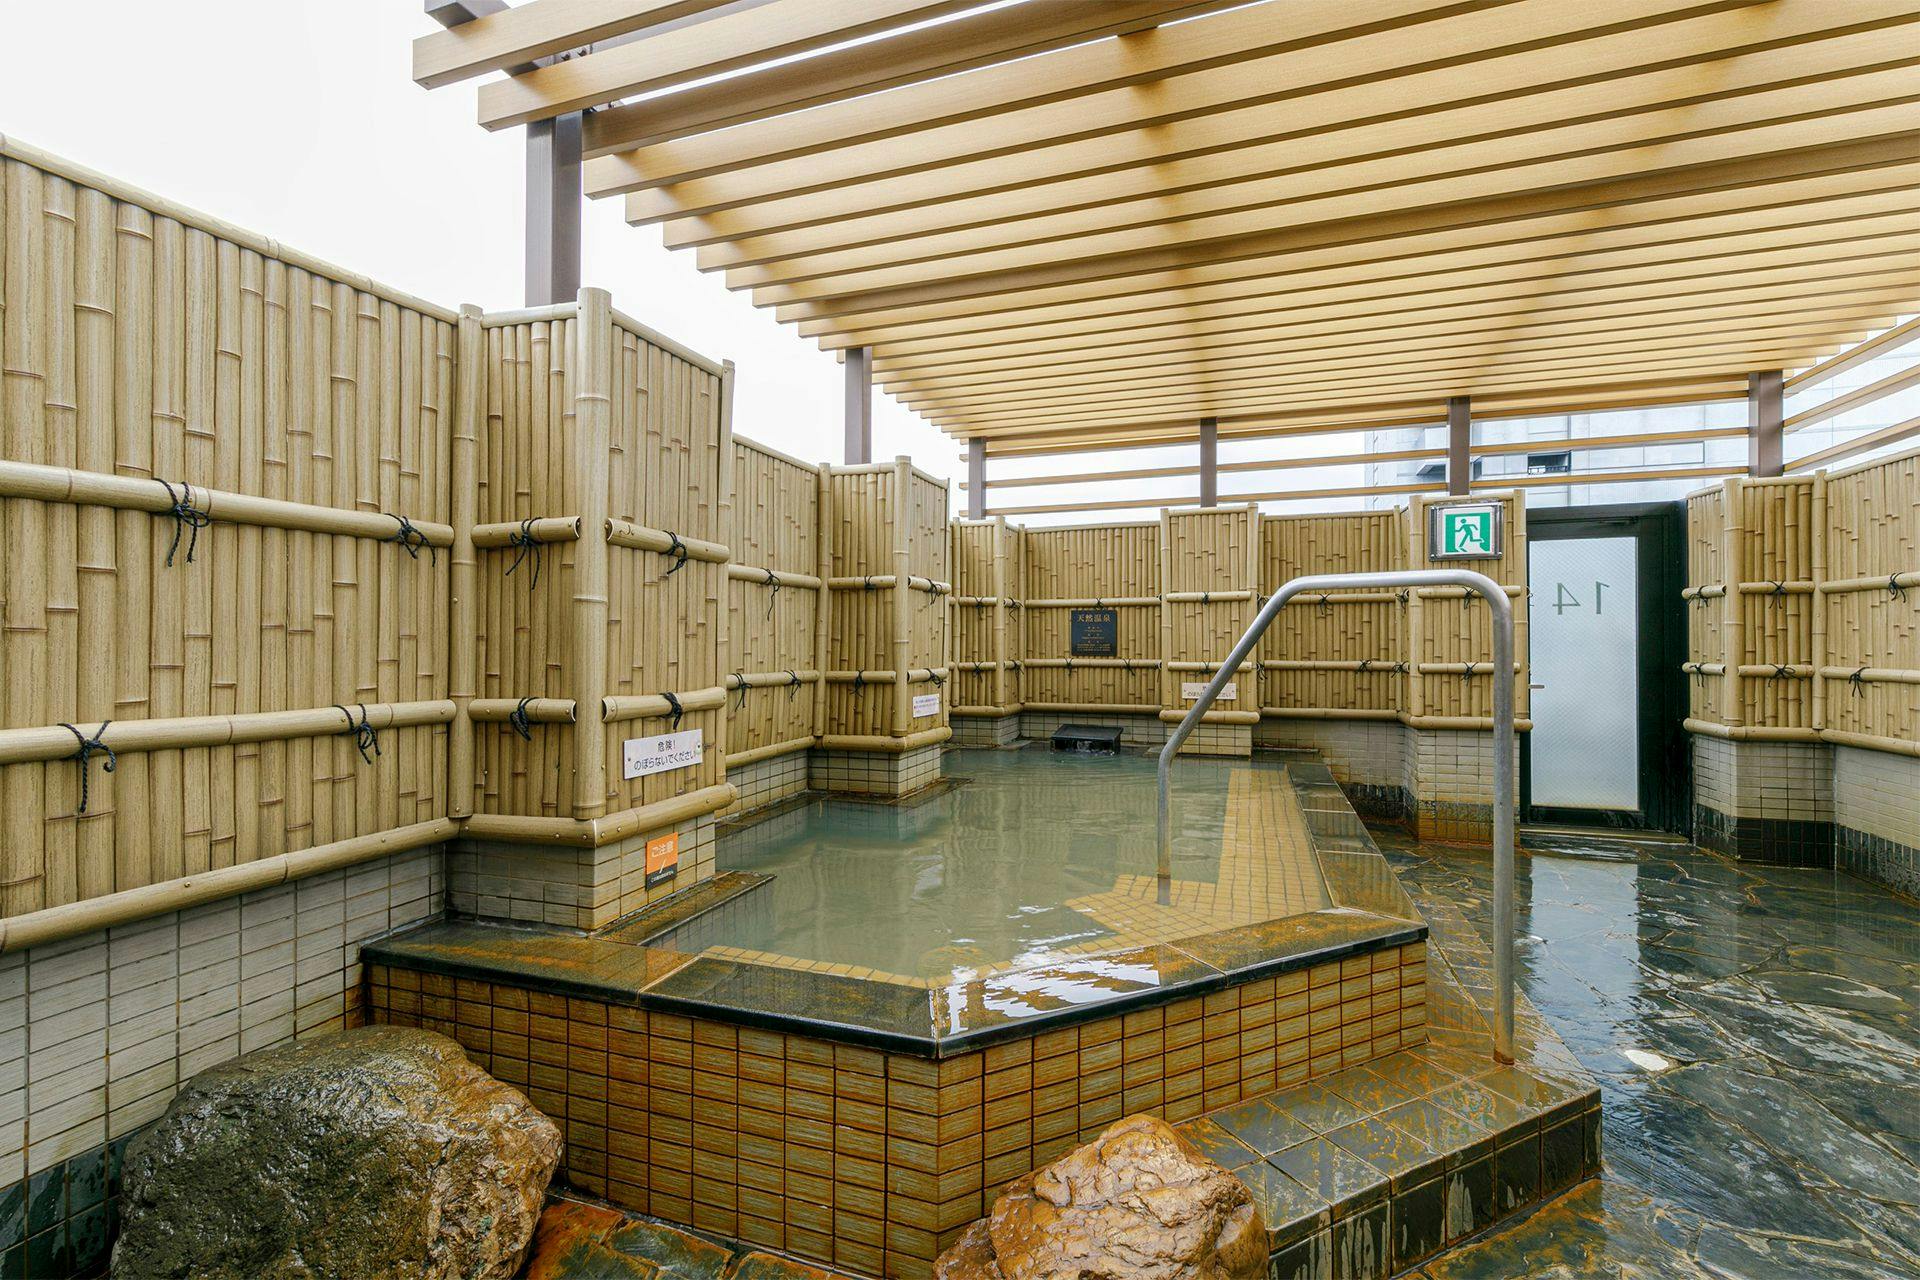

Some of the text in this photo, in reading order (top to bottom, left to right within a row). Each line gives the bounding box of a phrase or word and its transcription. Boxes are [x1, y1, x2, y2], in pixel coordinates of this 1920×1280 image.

[1078, 613, 1111, 623] 天然温泉
[651, 840, 674, 858] ご注意
